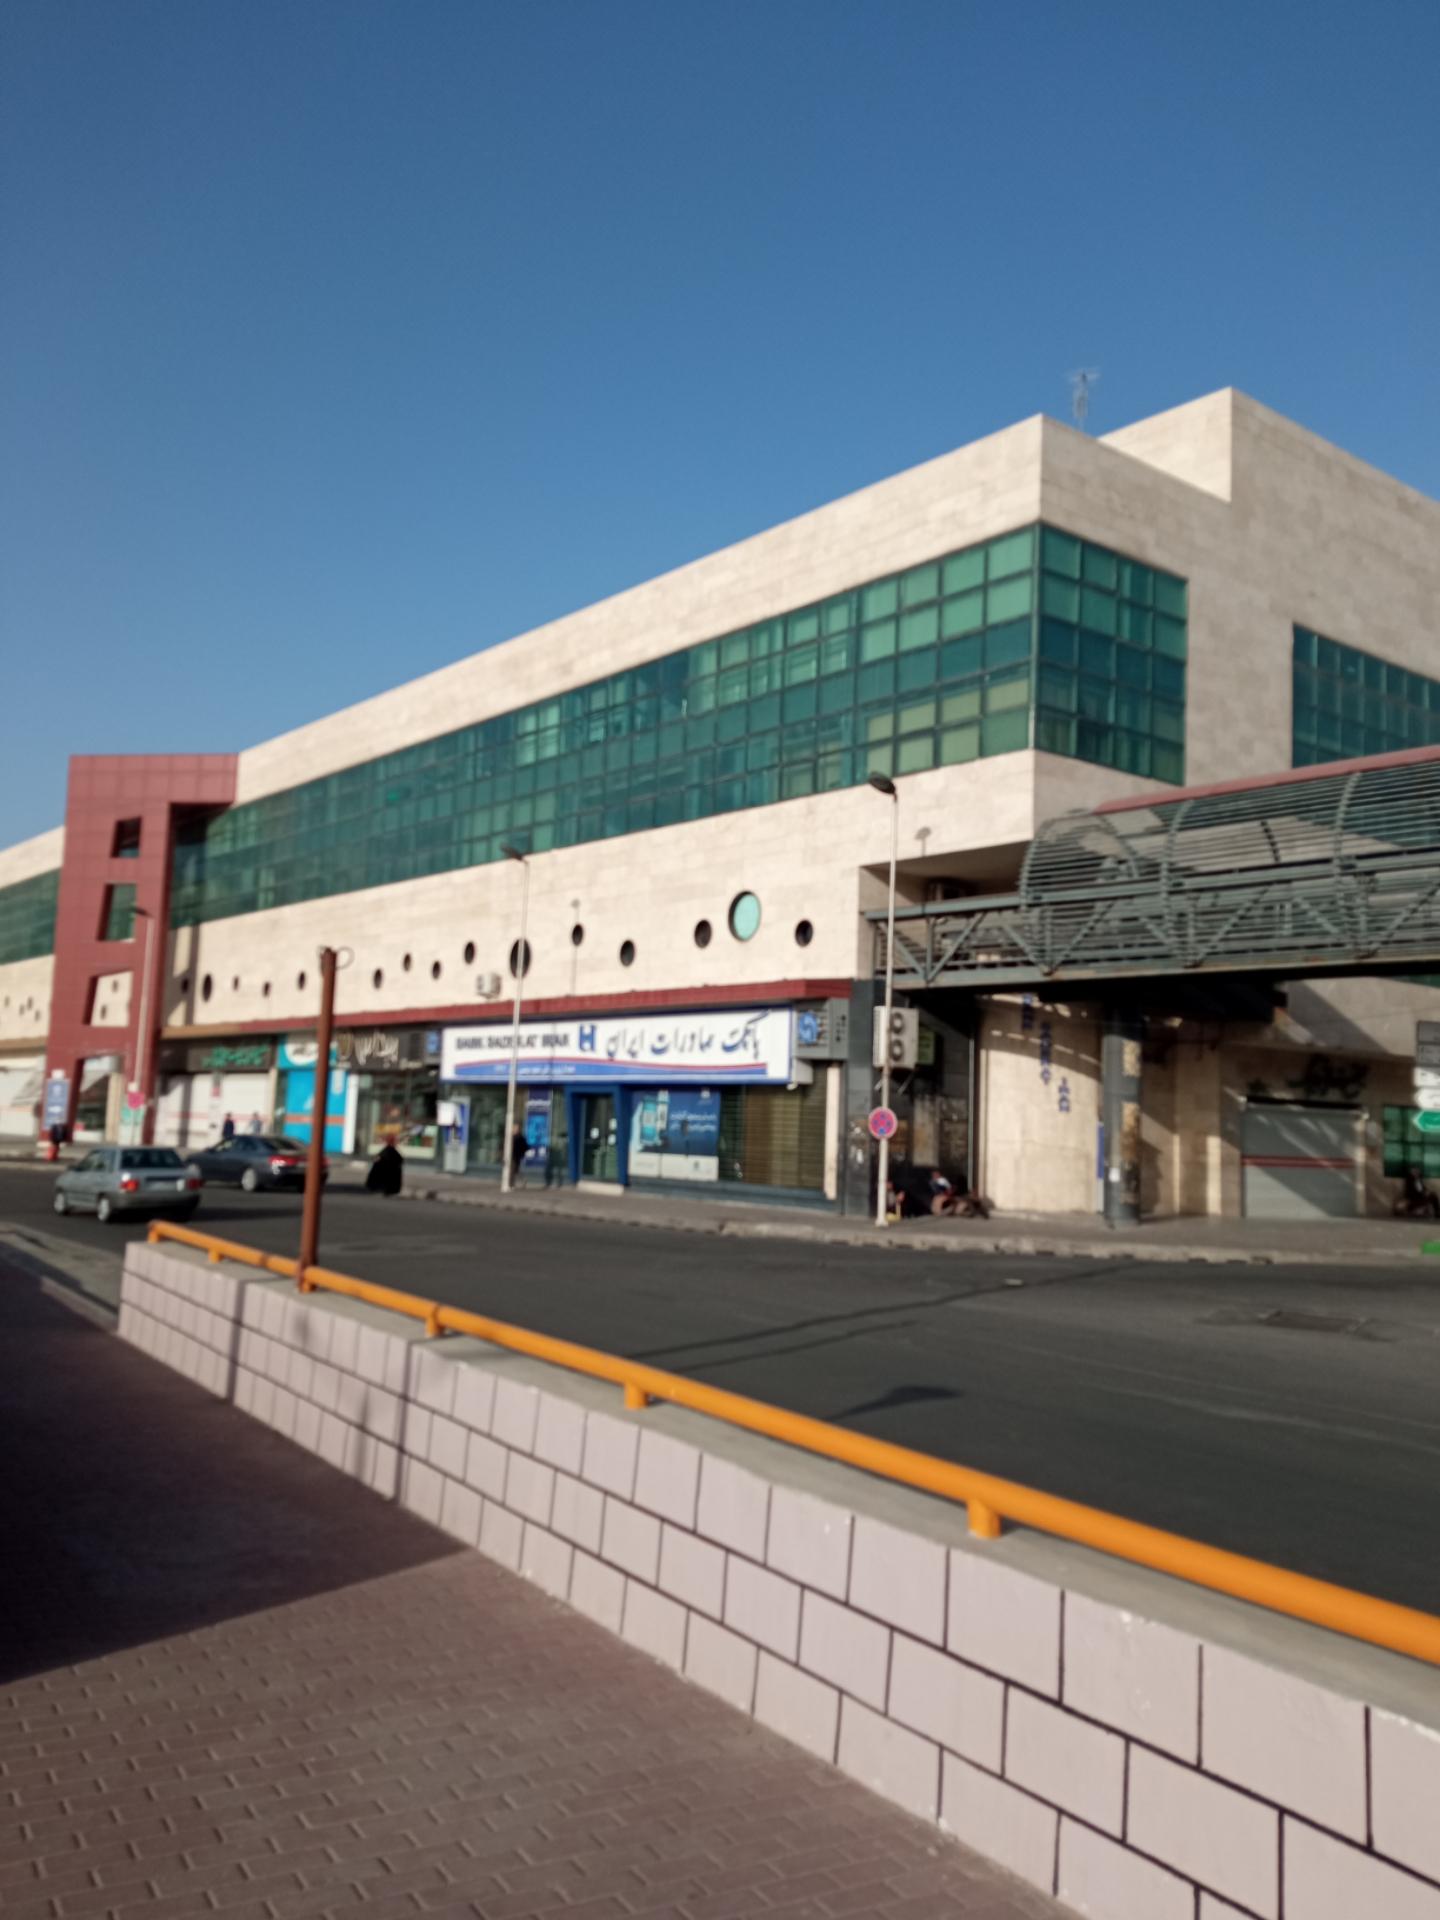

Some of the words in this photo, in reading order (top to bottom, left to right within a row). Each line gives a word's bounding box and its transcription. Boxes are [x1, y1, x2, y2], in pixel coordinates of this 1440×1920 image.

[606, 1026, 646, 1062] ایران
[650, 1026, 716, 1055] صادرات
[721, 1008, 769, 1060] بانک
